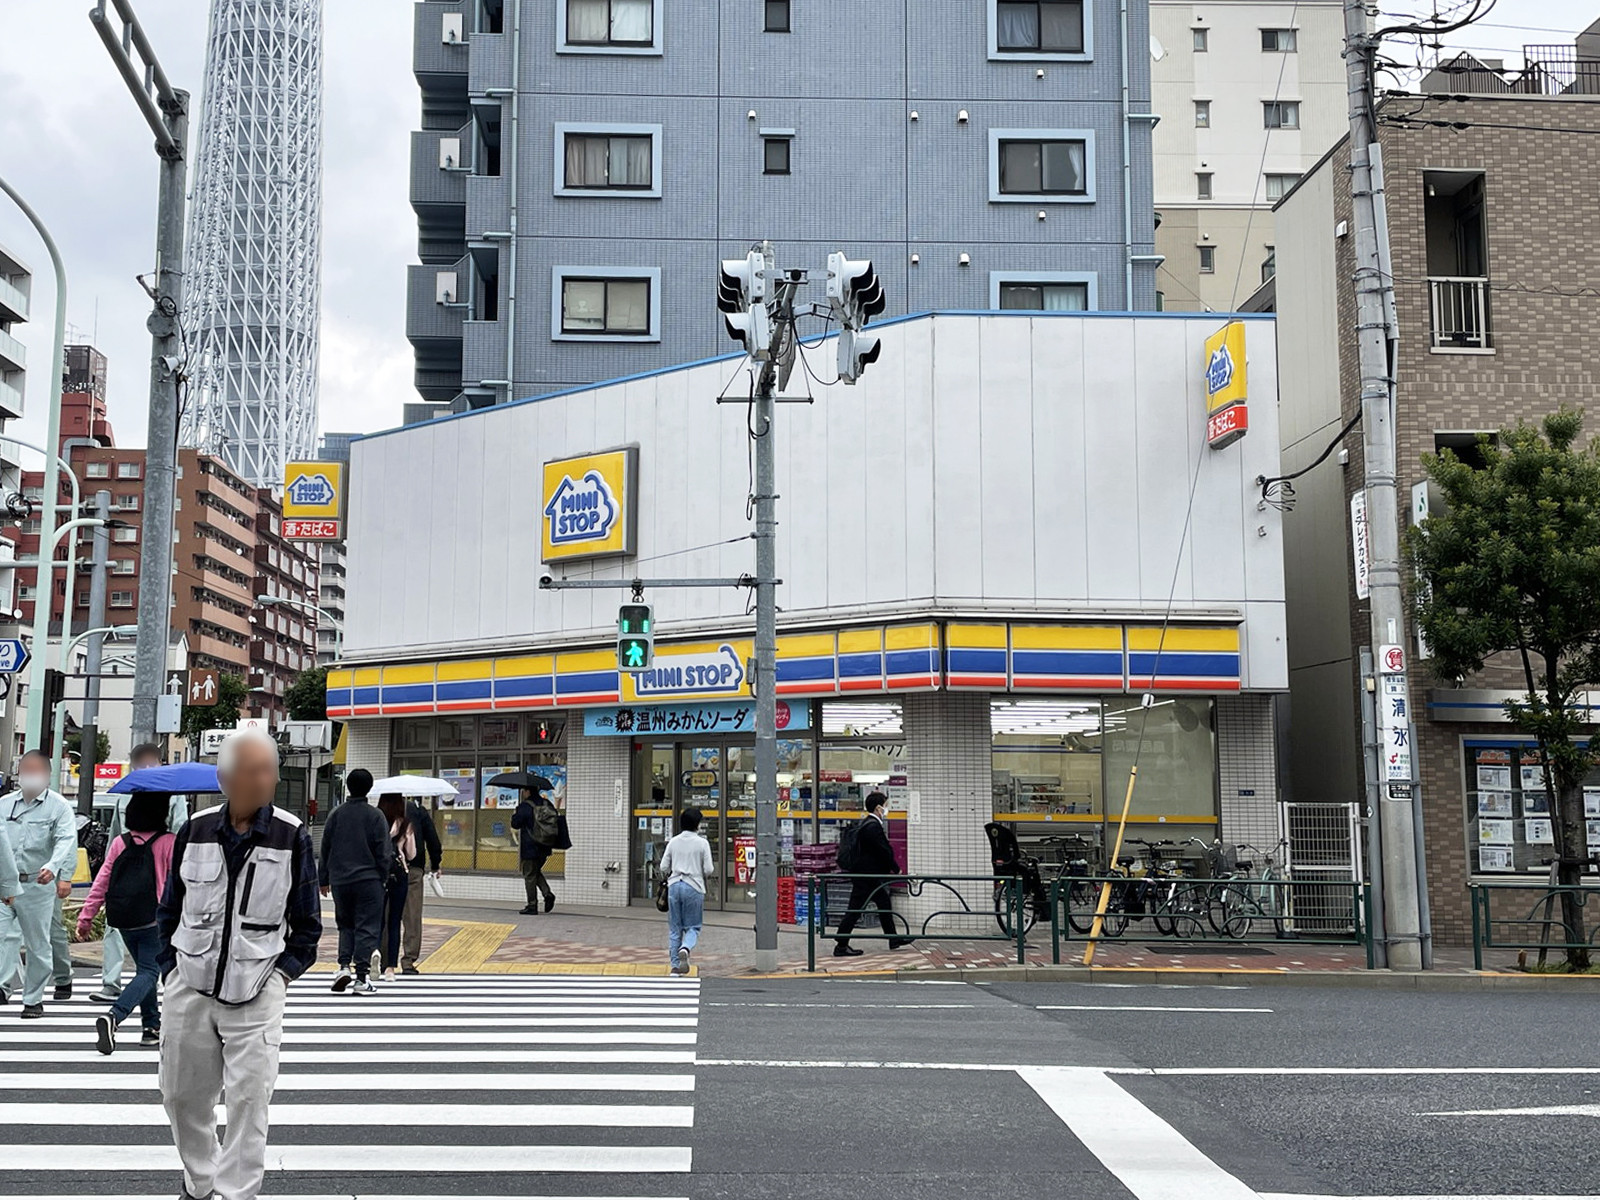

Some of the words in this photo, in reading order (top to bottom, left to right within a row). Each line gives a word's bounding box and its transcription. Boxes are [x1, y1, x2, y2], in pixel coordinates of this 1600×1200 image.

[1211, 370, 1227, 388] STOP
[297, 492, 325, 501] STOP
[298, 483, 324, 492] MINI
[560, 490, 599, 513] MINI
[558, 511, 601, 534] STOP
[642, 666, 682, 689] MINI
[685, 663, 733, 687] STOP
[636, 708, 750, 732] 温州みかんソーダ
[1391, 698, 1408, 746] 清水
